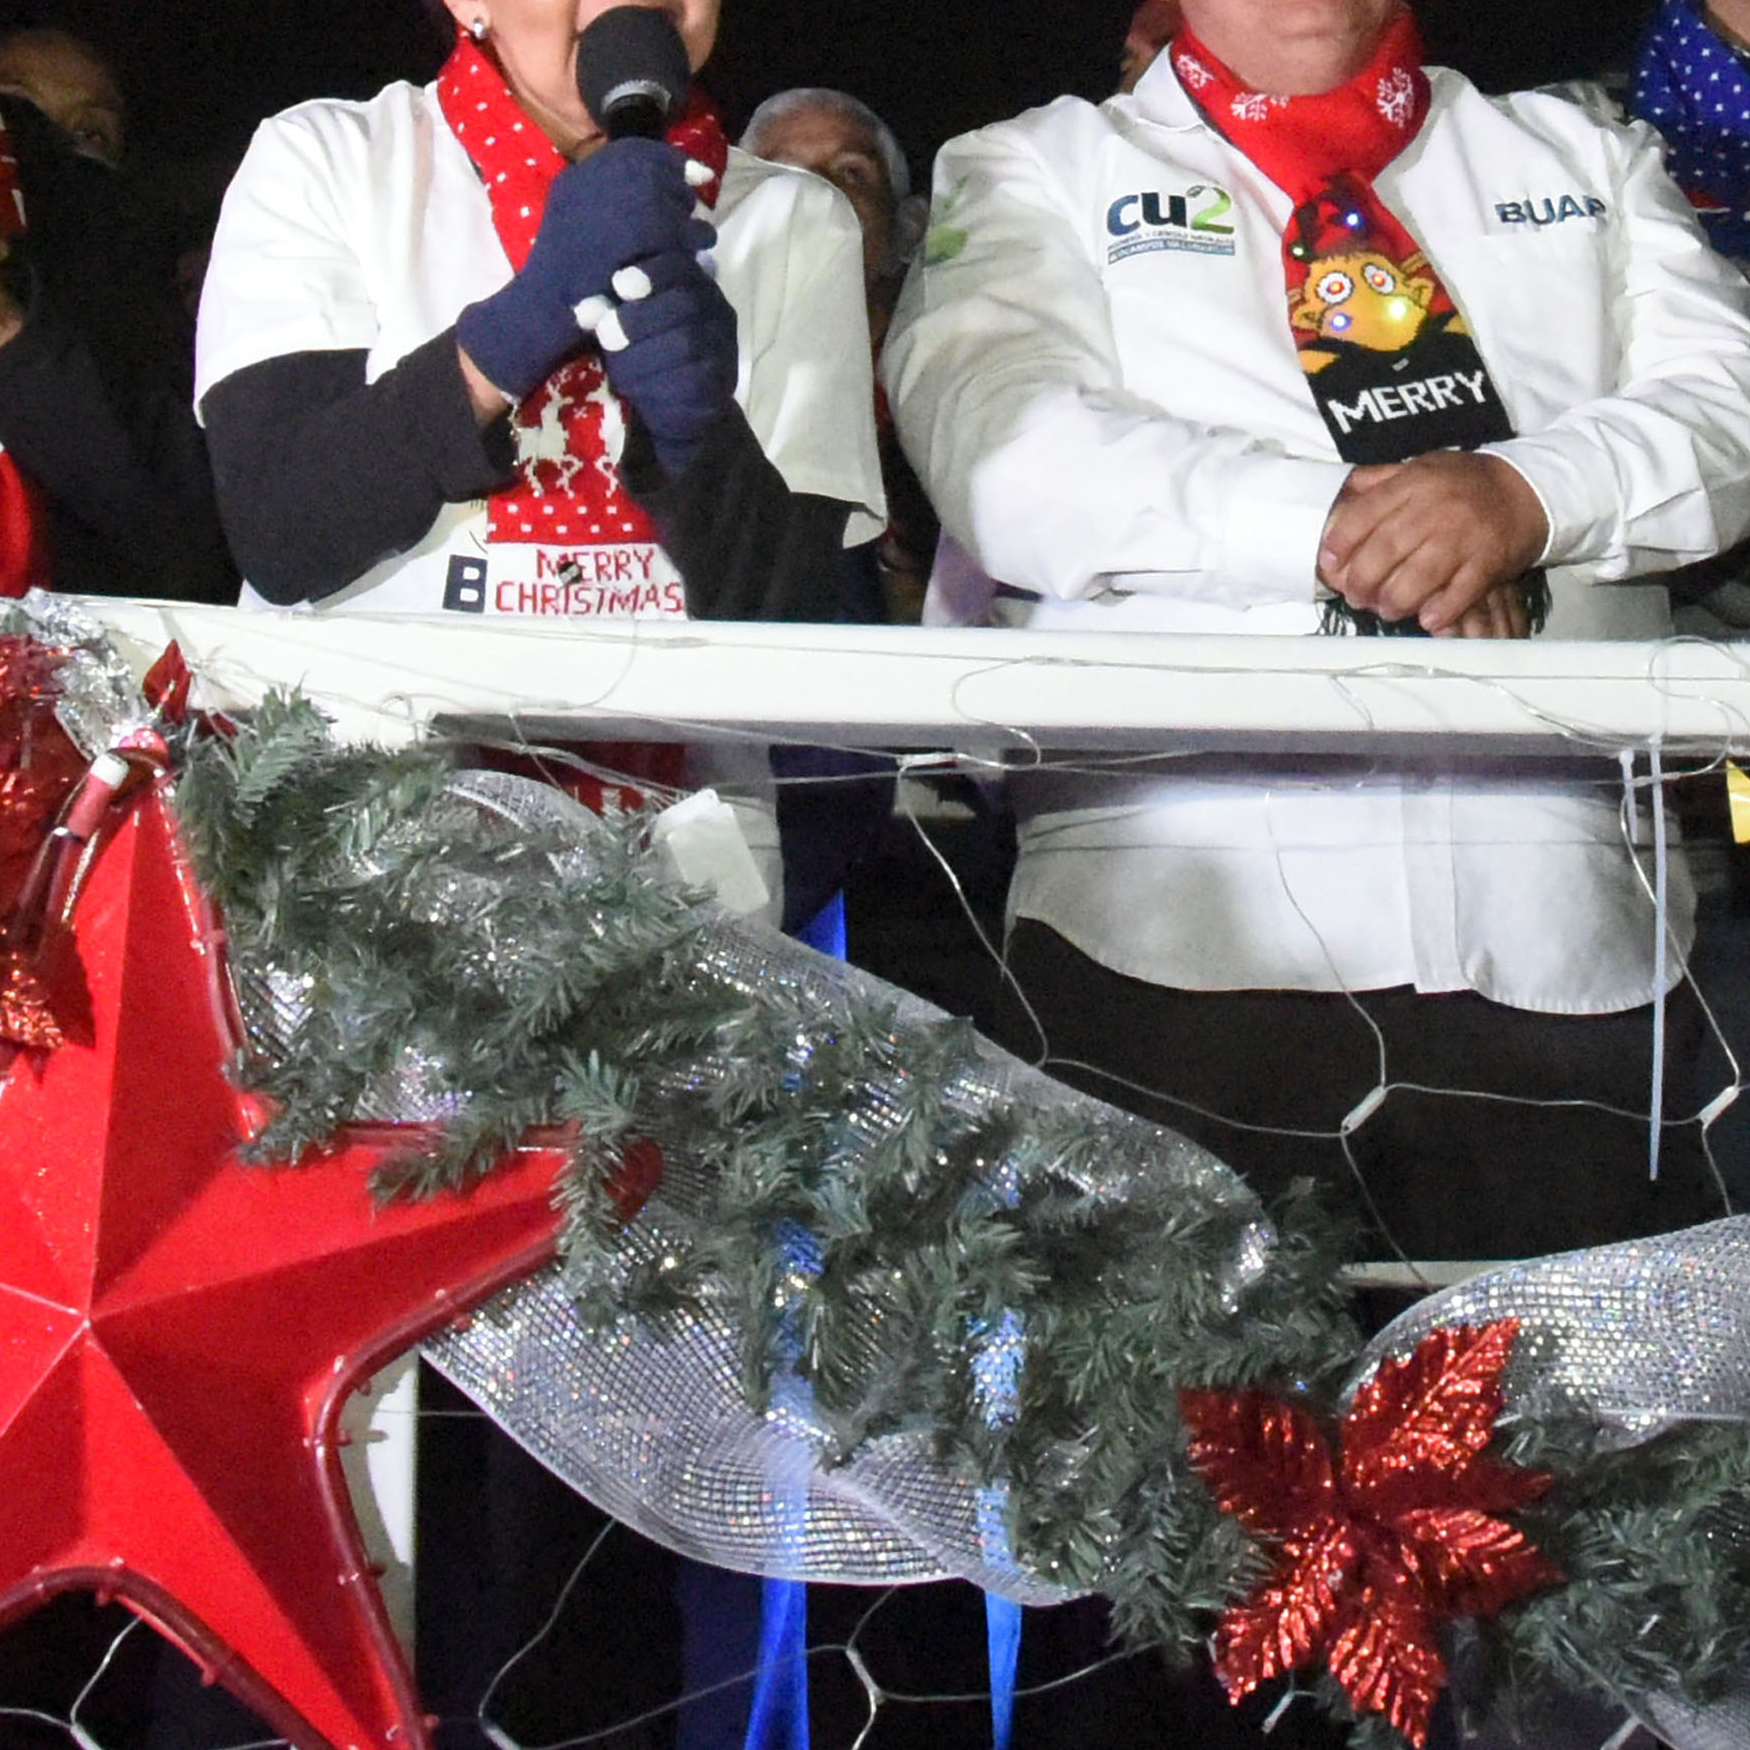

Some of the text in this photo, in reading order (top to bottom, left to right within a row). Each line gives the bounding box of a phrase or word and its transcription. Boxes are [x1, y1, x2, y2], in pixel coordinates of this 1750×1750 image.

[1494, 194, 1607, 226] BUAP
[1327, 369, 1487, 435] MERRY
[536, 548, 654, 583] MERRY
[495, 580, 685, 616] CHRISTMAS
